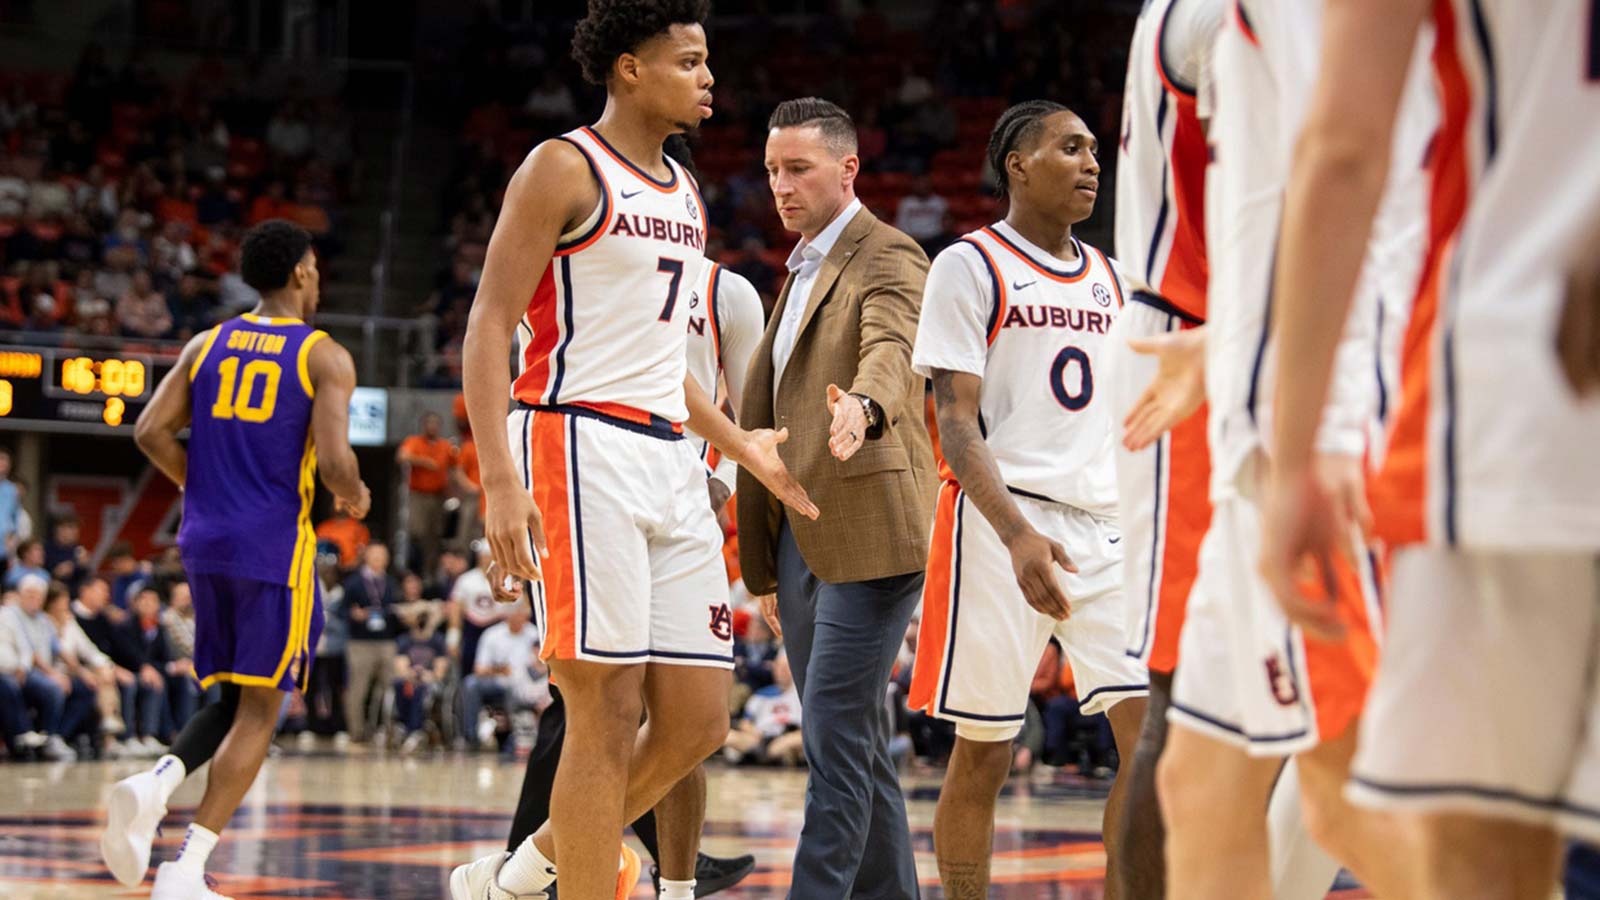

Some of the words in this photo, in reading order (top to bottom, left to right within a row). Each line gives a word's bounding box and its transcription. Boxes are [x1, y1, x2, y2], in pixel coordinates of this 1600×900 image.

[609, 213, 704, 251] AUBURN
[657, 256, 684, 323] 7
[226, 329, 287, 355] SUTTON
[212, 356, 282, 423] 10
[1049, 345, 1094, 412] 0
